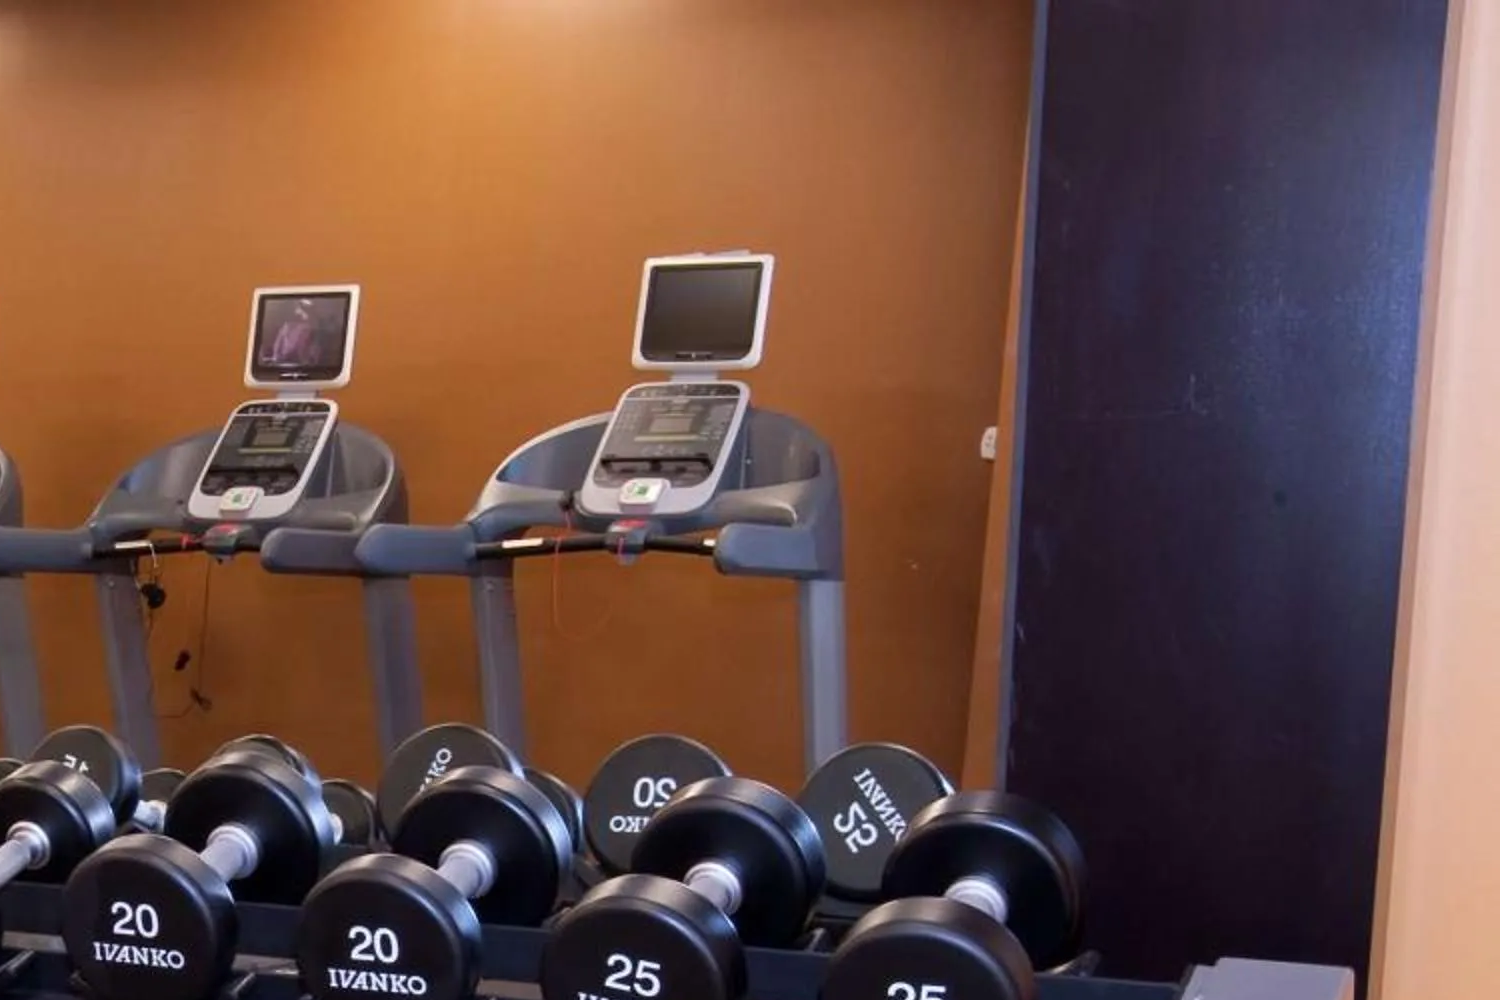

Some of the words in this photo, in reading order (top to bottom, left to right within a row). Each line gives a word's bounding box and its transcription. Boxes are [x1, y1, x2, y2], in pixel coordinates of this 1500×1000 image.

[111, 901, 159, 939] 20
[93, 941, 185, 970] IVANKO
[348, 925, 400, 963] 20
[327, 967, 427, 996] IVANKO
[604, 953, 661, 997] 25
